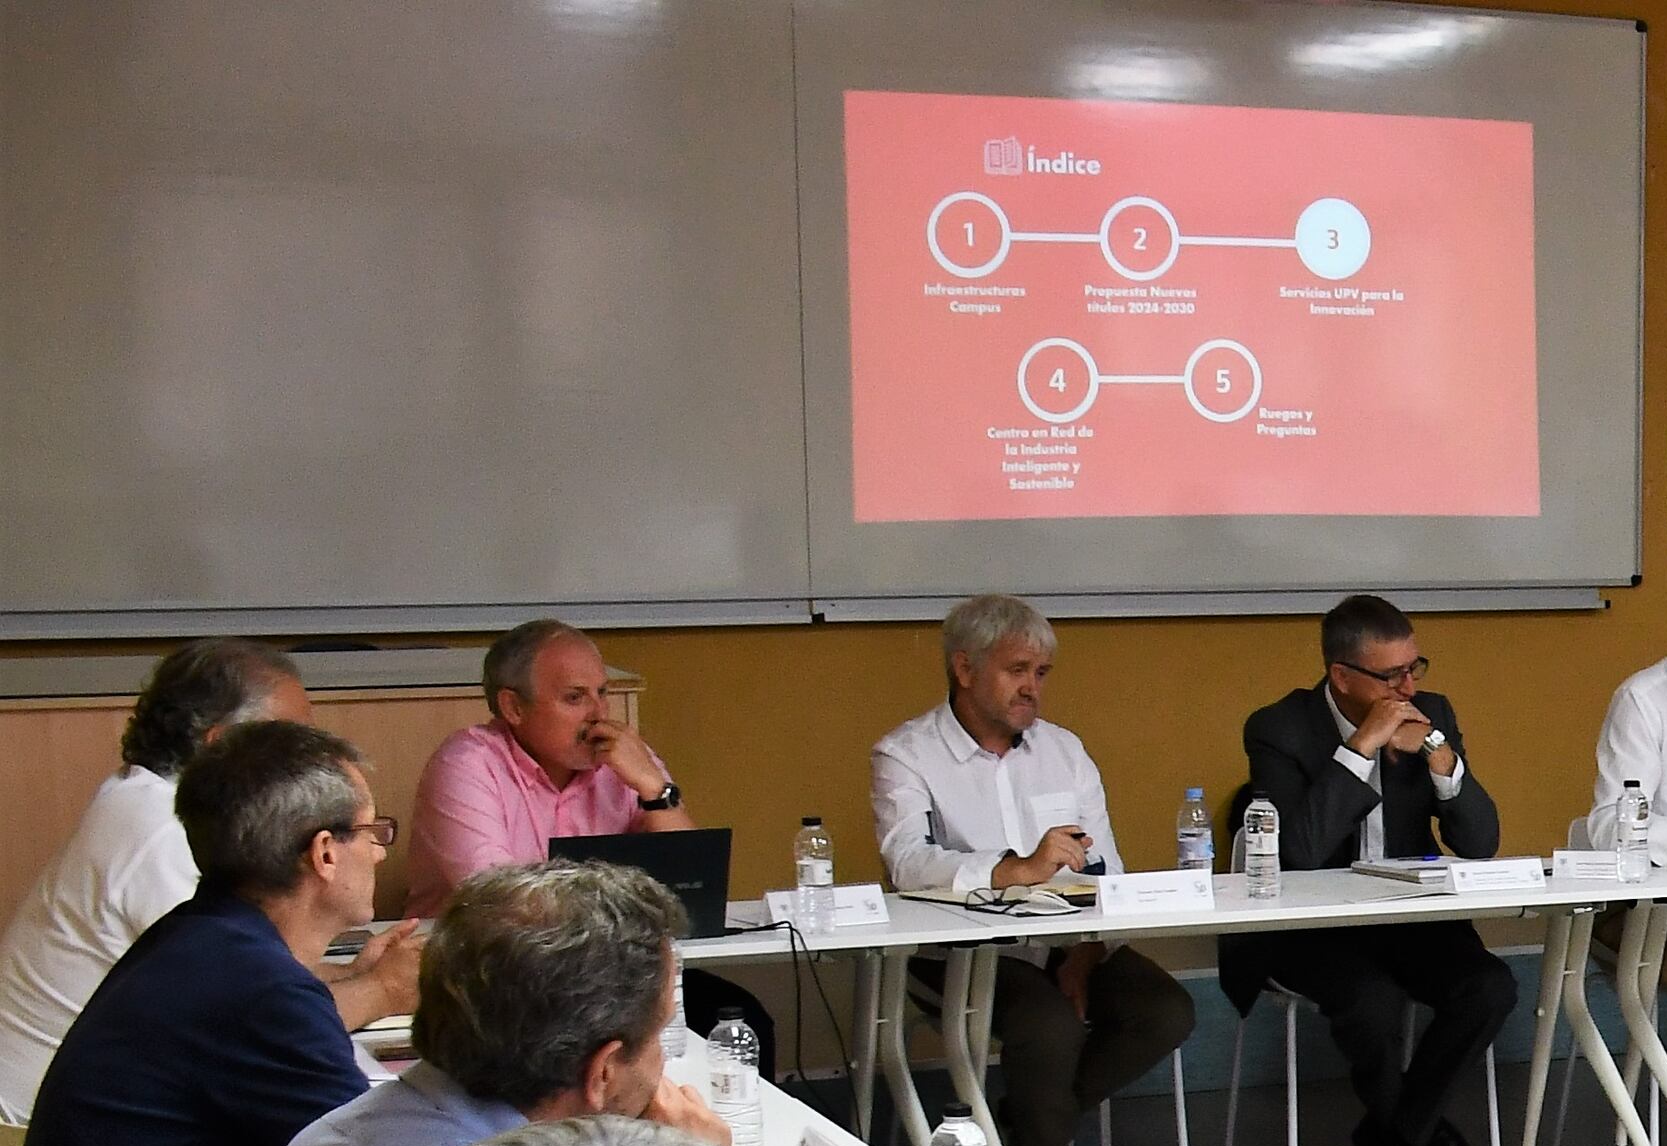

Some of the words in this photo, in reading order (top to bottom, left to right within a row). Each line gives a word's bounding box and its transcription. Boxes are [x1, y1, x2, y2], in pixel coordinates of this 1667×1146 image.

[1027, 145, 1101, 175] Índice
[962, 222, 975, 247] 1
[1133, 228, 1147, 250] 2
[1326, 229, 1340, 250] 3
[924, 283, 1026, 297] Infraestructuras
[1084, 284, 1147, 299] Propuesta
[1150, 285, 1197, 298] Nuevos
[1279, 286, 1332, 299] Servicios
[1334, 288, 1360, 300] UPV
[1361, 290, 1391, 302] para
[1392, 288, 1404, 301] la
[949, 301, 1001, 315] Campus
[1310, 303, 1376, 316] Innovación
[1048, 367, 1067, 393] 4
[1215, 369, 1231, 393] 5
[1258, 407, 1303, 422] Ruegos
[1304, 410, 1313, 423] y
[987, 427, 1029, 439] Centro
[1031, 428, 1048, 438] en
[1050, 426, 1075, 438] Red
[1077, 425, 1094, 438] de
[1256, 423, 1317, 438] Preguntas
[1005, 443, 1018, 455] la
[1020, 443, 1078, 455] Industria
[1002, 460, 1070, 475] Inteligente
[1071, 461, 1081, 474] y
[1009, 477, 1075, 490] Sostenible
